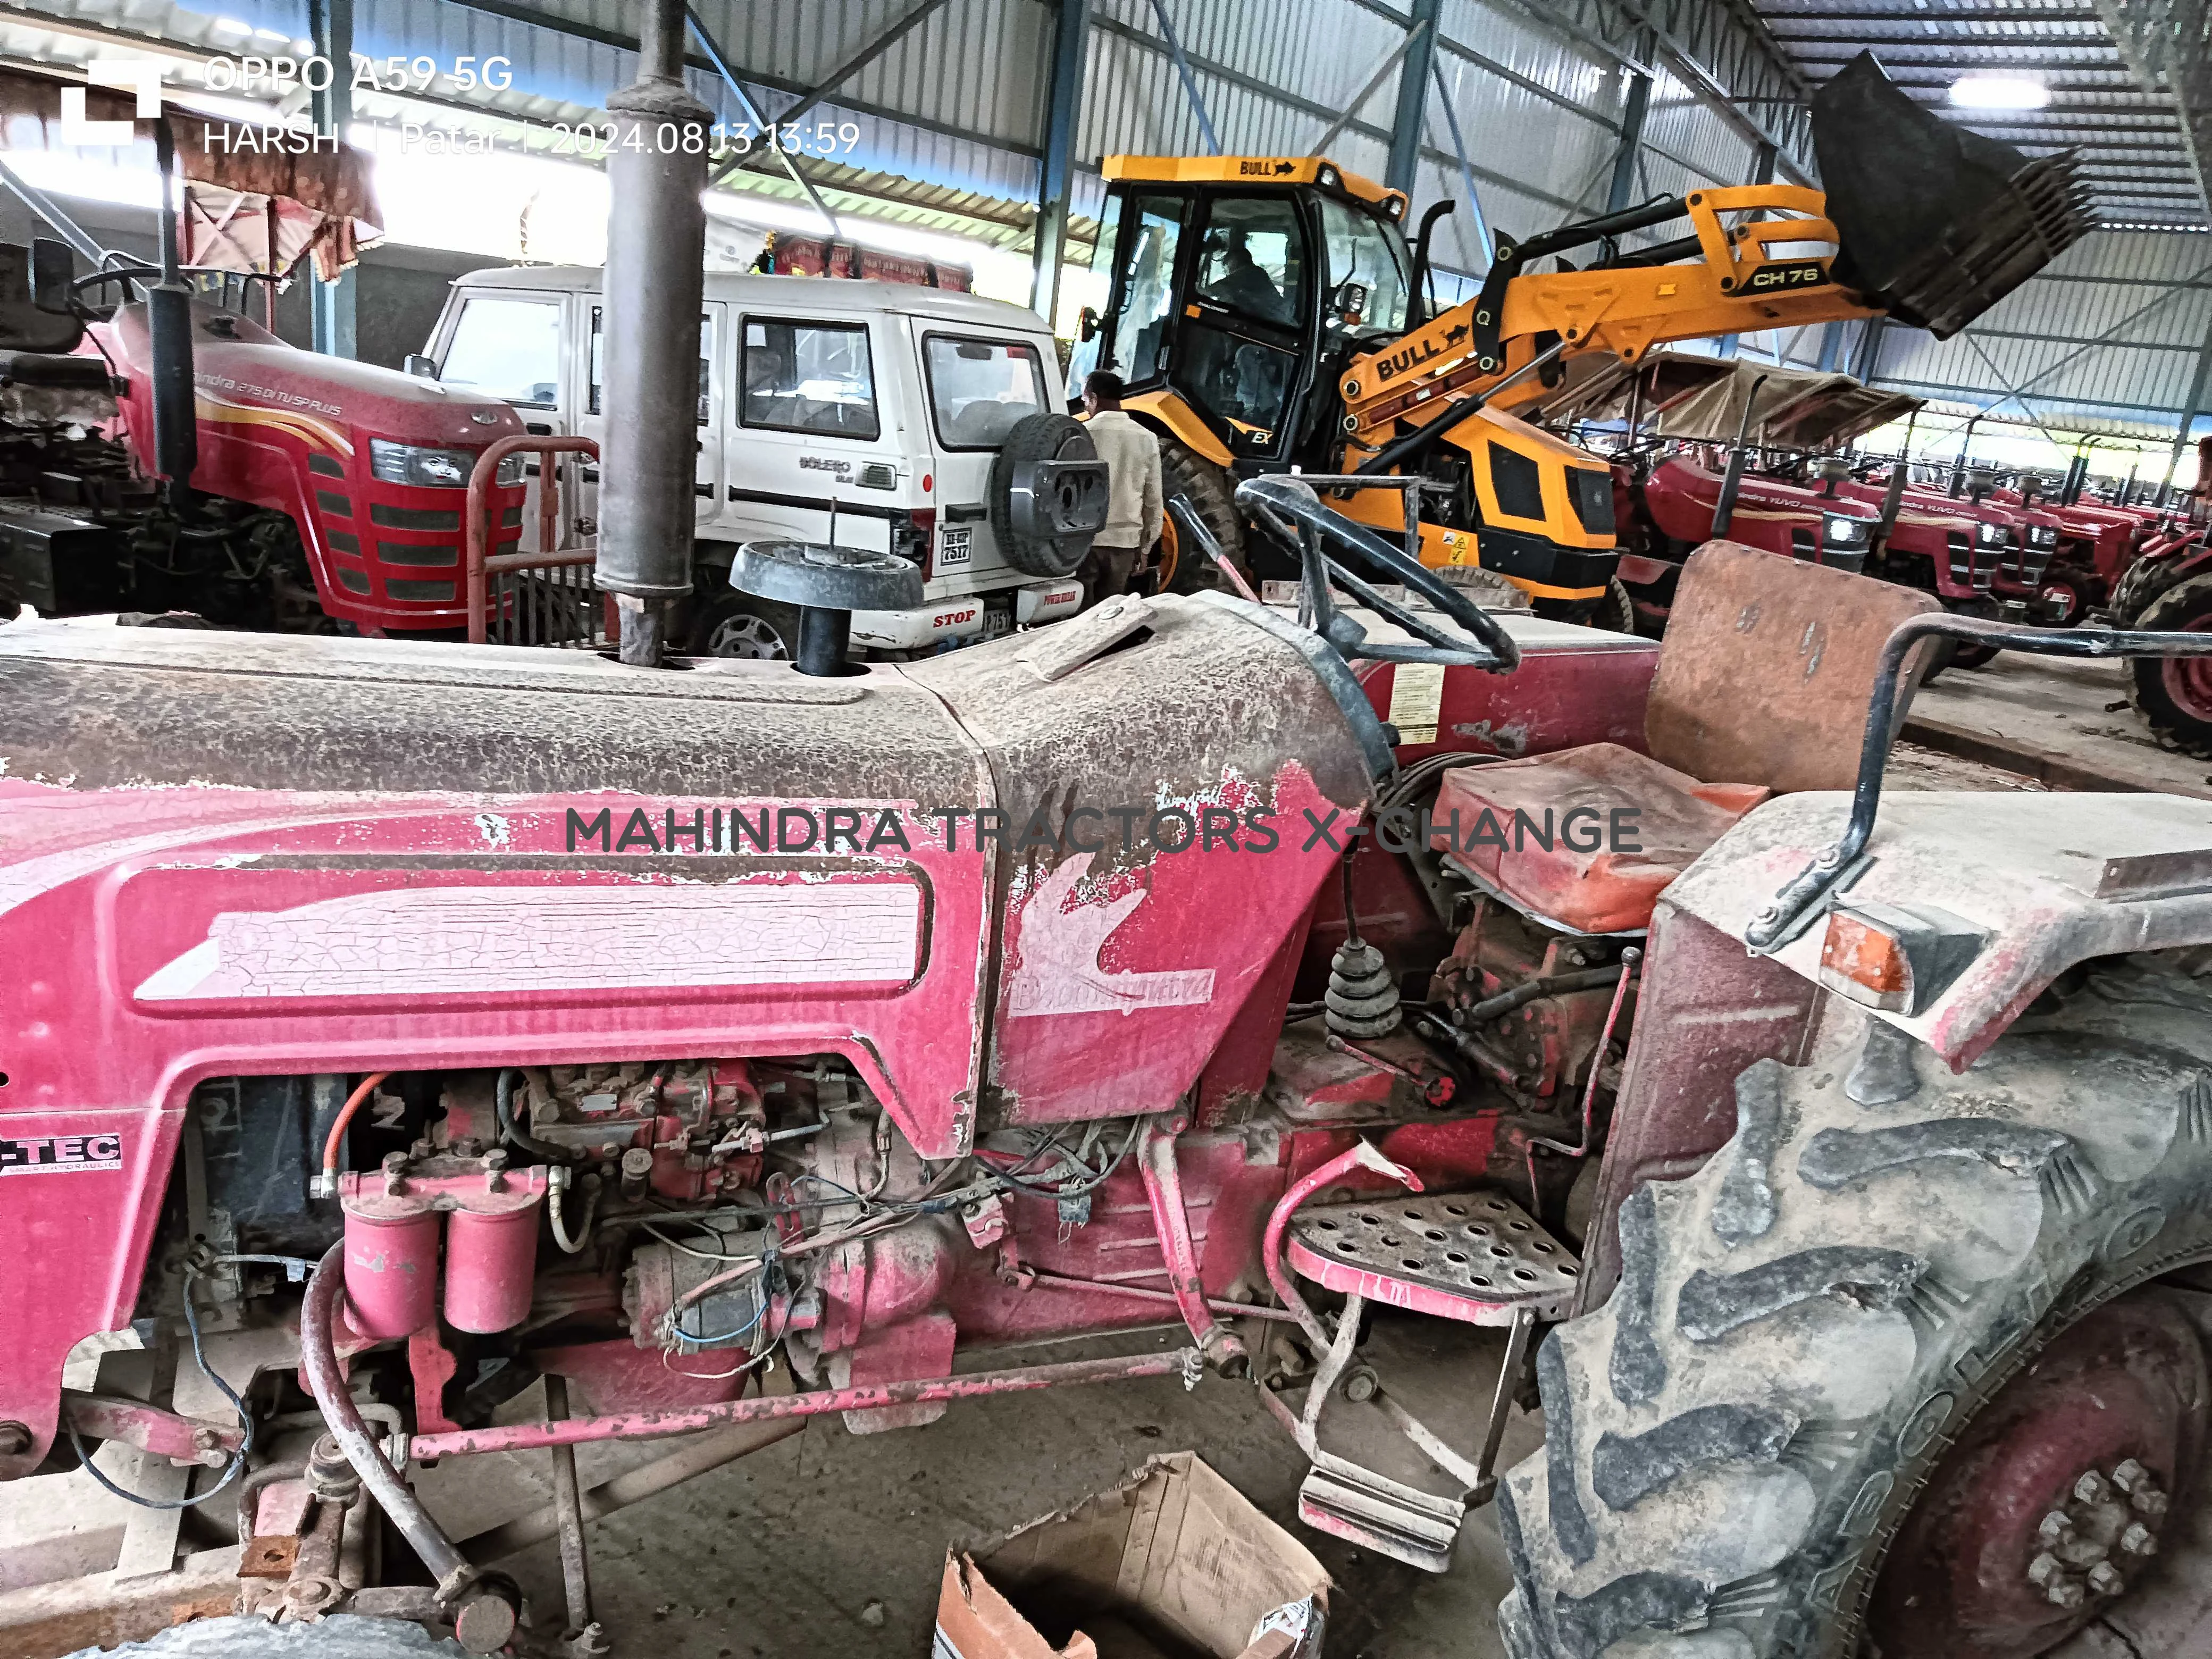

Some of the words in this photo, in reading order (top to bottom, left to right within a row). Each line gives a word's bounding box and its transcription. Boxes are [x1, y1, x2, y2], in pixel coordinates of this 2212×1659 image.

[1239, 161, 1271, 175] BULL
[1754, 271, 1785, 286] CH
[1376, 339, 1440, 383] BULL
[799, 456, 851, 473] BOLERO
[944, 545, 968, 560] 7517
[933, 609, 976, 628] STOP
[51, 1161, 120, 1170] HYDRAULICS
